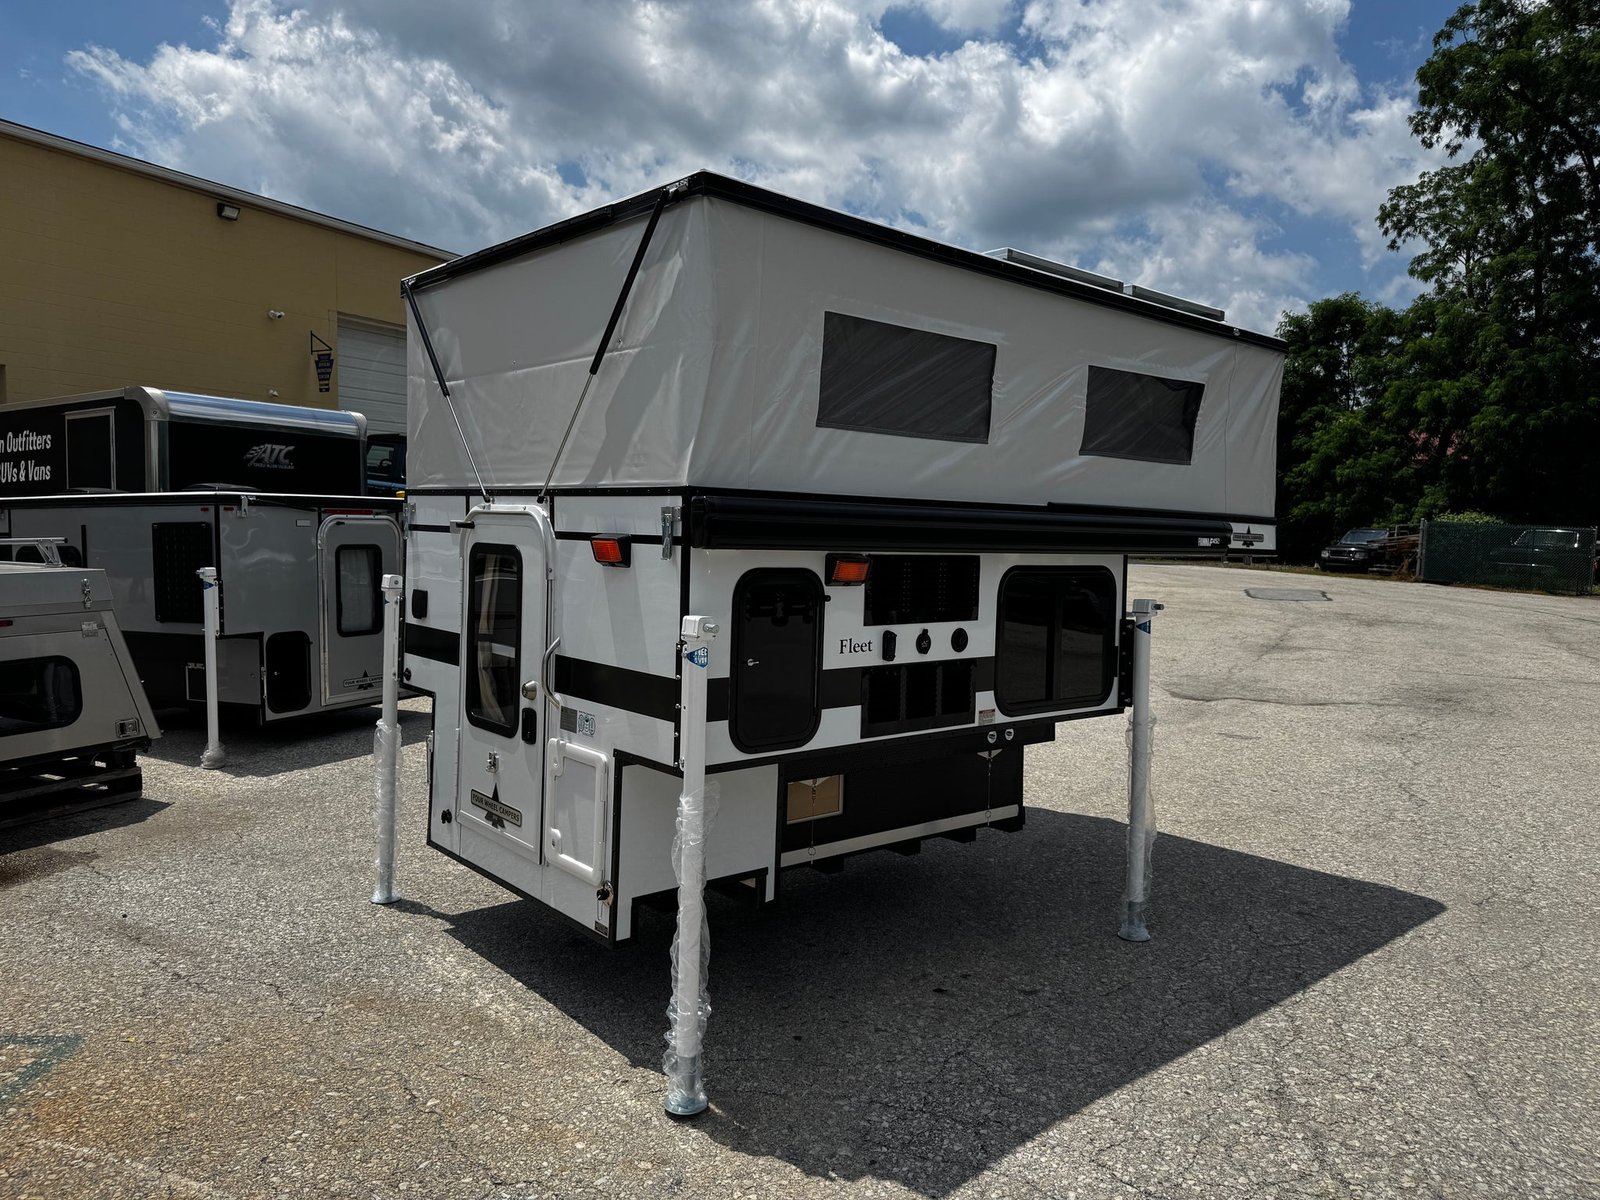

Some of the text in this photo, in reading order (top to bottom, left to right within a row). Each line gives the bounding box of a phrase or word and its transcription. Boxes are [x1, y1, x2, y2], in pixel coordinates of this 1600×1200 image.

[6, 430, 52, 452] Outfitters
[248, 443, 296, 464] ATC
[0, 459, 52, 483] UVs & Vans
[839, 637, 873, 655] Fleet
[472, 793, 520, 822] FOUR WHEEL CAMPERS
